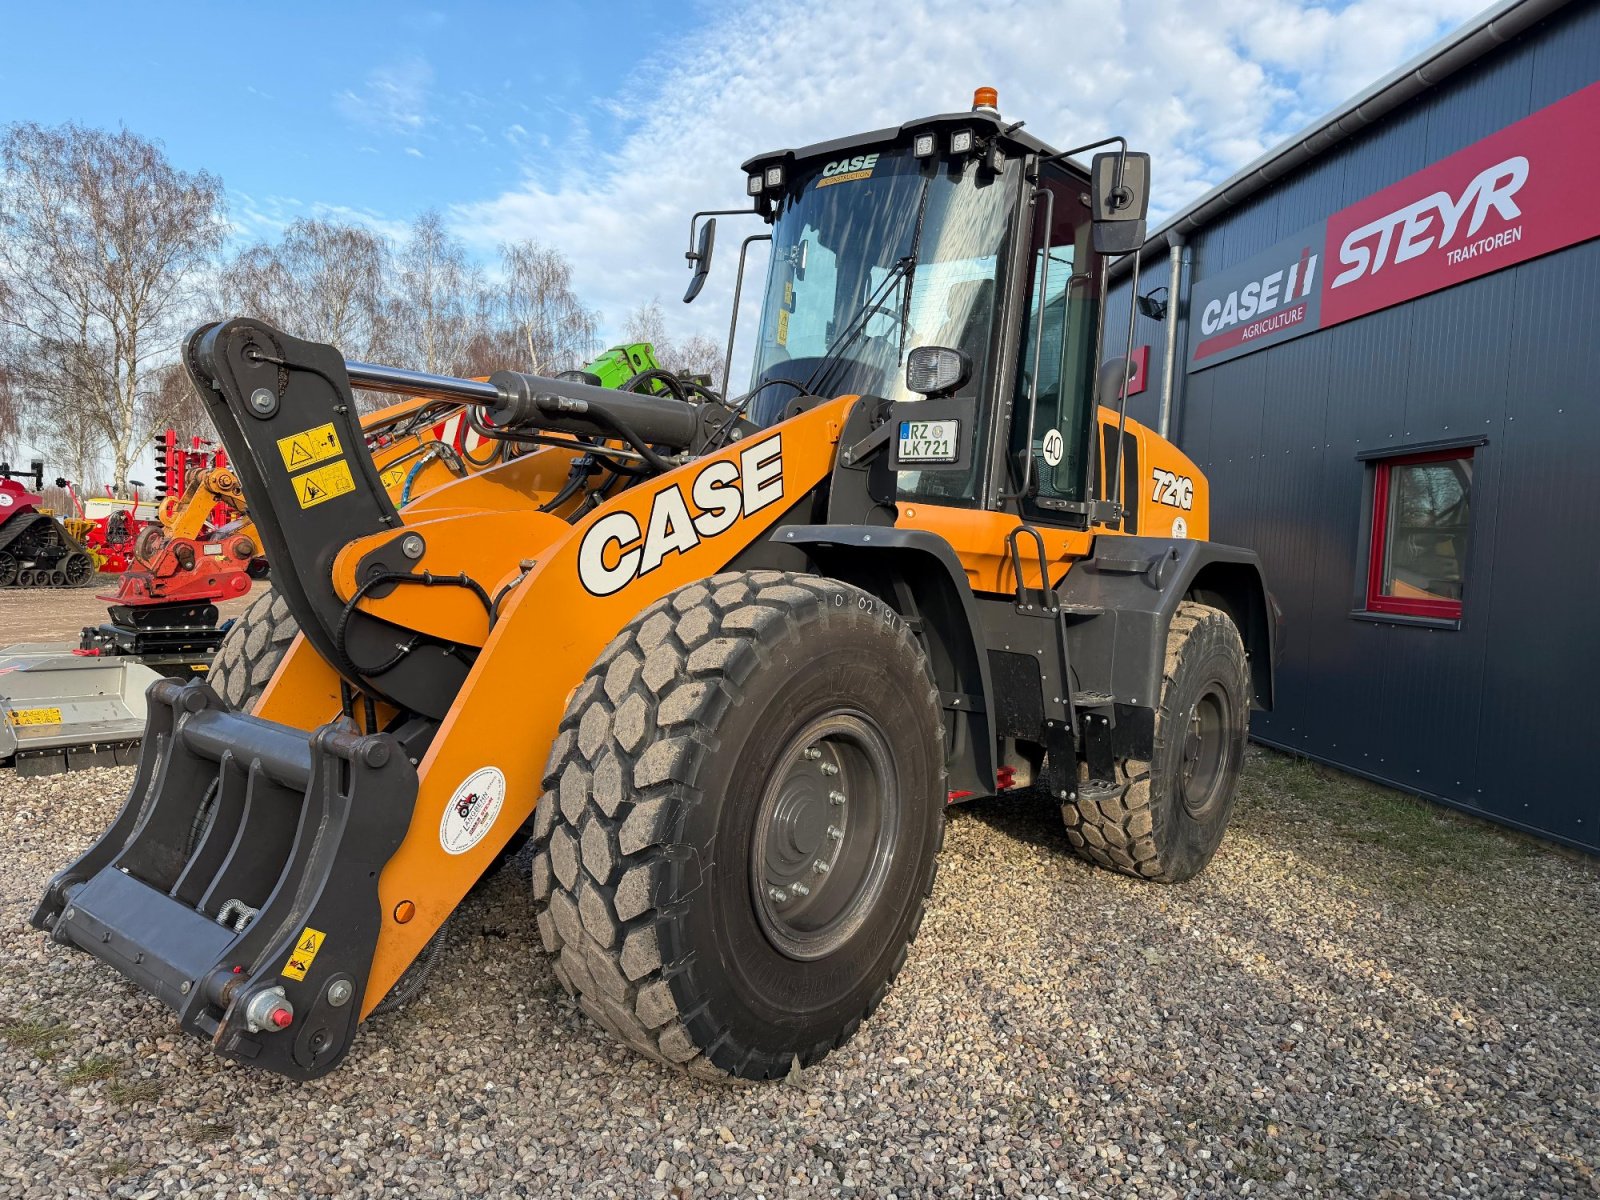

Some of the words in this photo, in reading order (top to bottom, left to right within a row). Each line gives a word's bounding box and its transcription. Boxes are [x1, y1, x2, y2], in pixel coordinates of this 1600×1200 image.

[822, 153, 880, 177] CASE
[823, 171, 870, 184] CONSTRUCTION
[1331, 156, 1530, 289] STEYR
[1447, 225, 1522, 266] TRAKTOREN
[1201, 269, 1284, 336] CASE
[1241, 306, 1304, 341] AGRICULTURE
[903, 440, 921, 456] LK
[924, 439, 949, 456] 721
[910, 424, 929, 440] RZ
[1045, 434, 1062, 461] 40
[1151, 466, 1194, 512] 721G
[577, 431, 784, 598] CASE
[858, 596, 873, 615] 02
